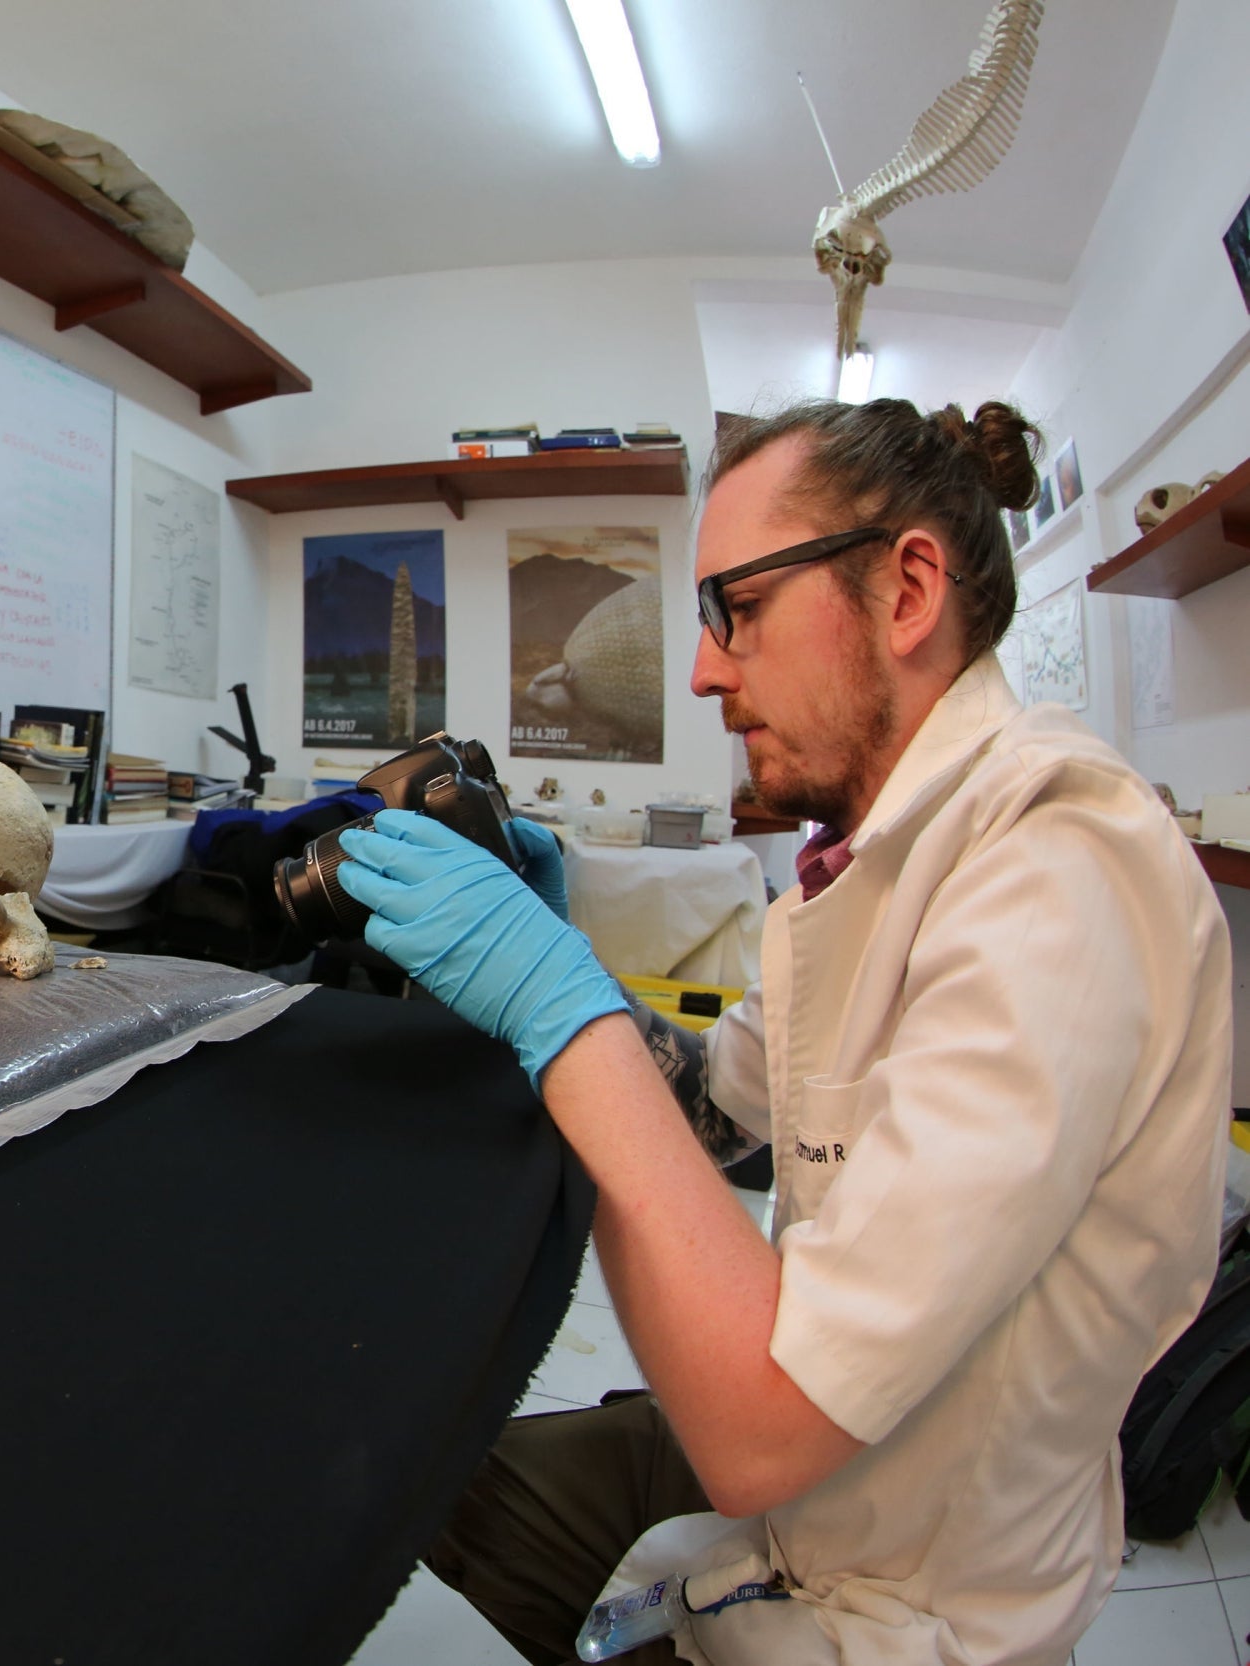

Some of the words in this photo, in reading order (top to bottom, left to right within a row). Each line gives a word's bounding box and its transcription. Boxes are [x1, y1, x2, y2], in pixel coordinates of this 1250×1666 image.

[317, 719, 356, 732] 6.4.2017
[512, 726, 524, 739] AB
[526, 727, 568, 741] 6.4.2017
[834, 1144, 846, 1162] R
